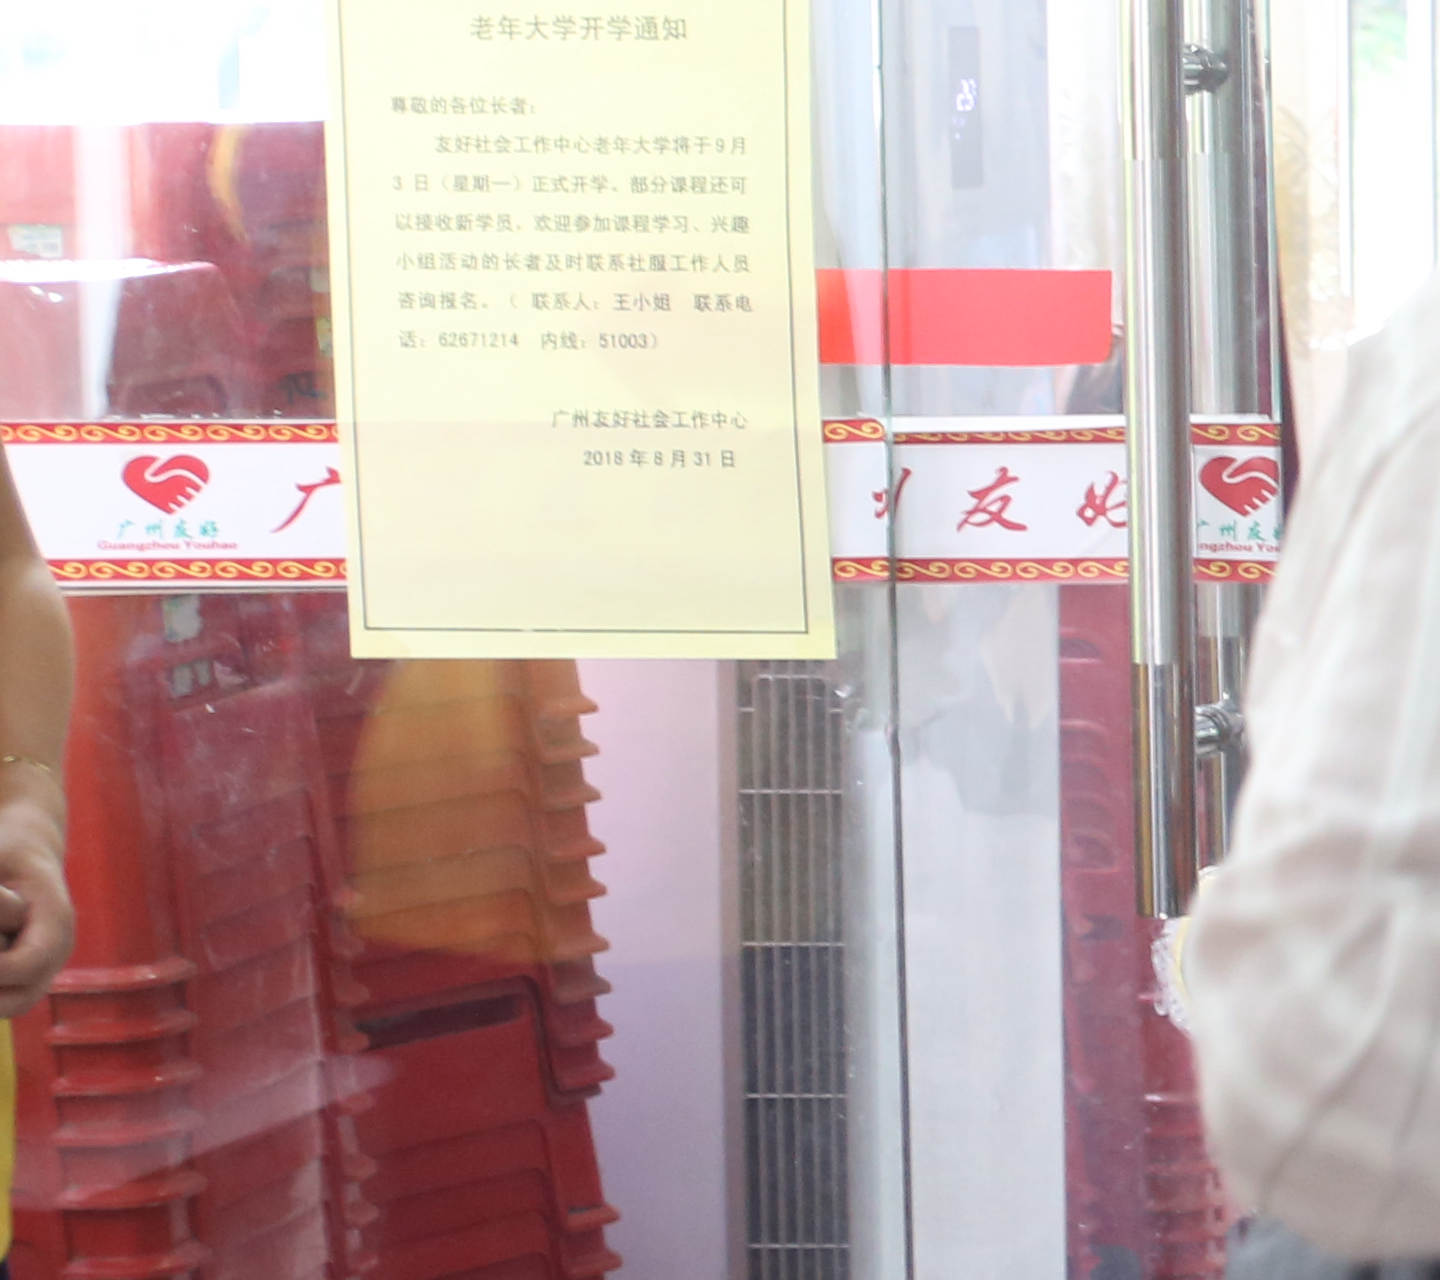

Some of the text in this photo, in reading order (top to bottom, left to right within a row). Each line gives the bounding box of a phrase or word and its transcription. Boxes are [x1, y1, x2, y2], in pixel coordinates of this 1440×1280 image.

[470, 14, 689, 42] 老年大学开学通知
[551, 409, 749, 432] 广州友好社会工作中心
